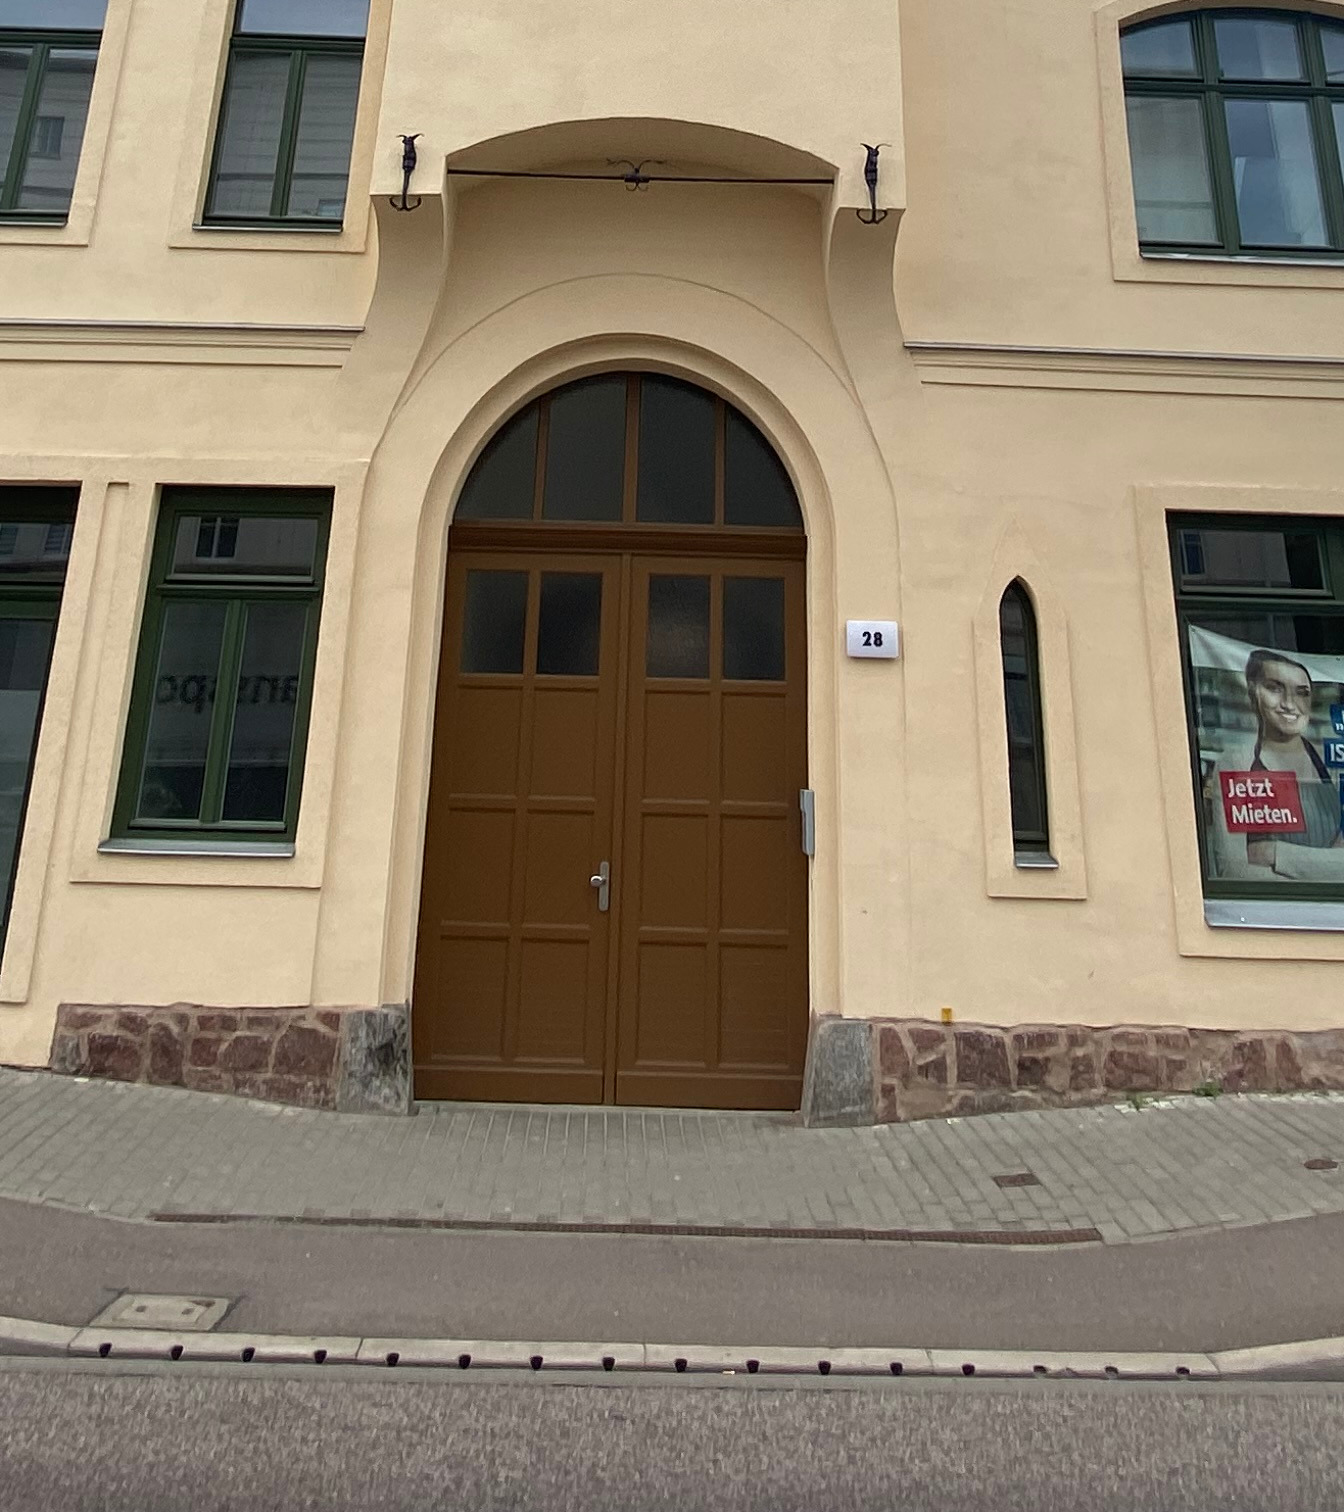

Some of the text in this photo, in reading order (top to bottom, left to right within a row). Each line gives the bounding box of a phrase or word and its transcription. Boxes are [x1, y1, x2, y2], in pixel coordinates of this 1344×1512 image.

[862, 631, 883, 647] 28
[1228, 778, 1274, 798] Jetzt
[1232, 803, 1297, 824] Mieten.
